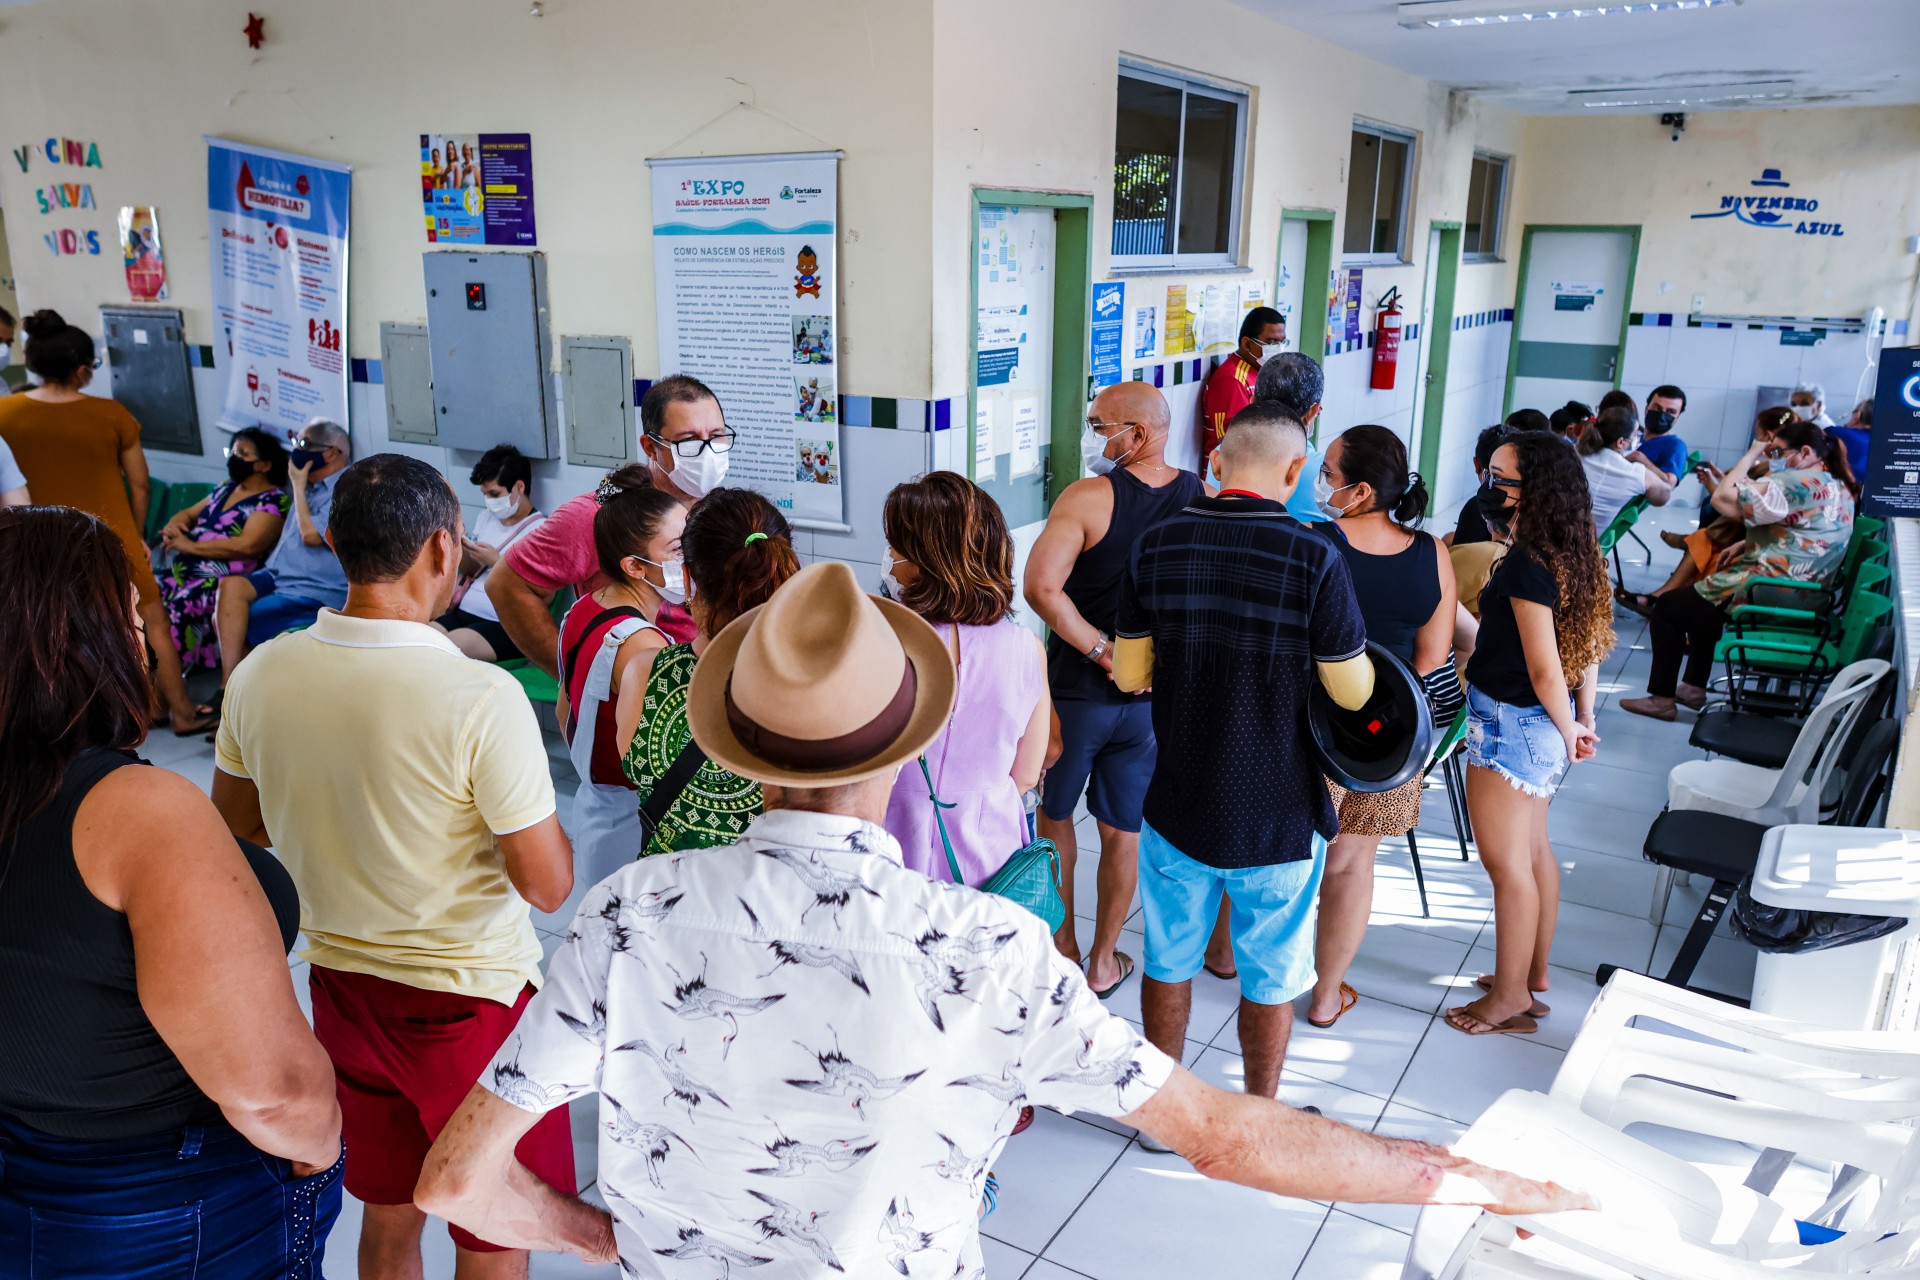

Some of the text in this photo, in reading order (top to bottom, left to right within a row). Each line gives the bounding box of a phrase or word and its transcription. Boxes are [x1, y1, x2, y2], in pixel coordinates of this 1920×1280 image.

[14, 137, 102, 173] VCINA
[692, 180, 744, 195] EXPO
[36, 182, 97, 214] SALVA
[1720, 196, 1818, 212] NOVEMBRO
[1795, 221, 1844, 236] AZUL
[43, 228, 101, 256] VIDAS
[673, 248, 697, 256] COMO
[700, 248, 735, 256] NASCEM
[738, 248, 749, 256] OS
